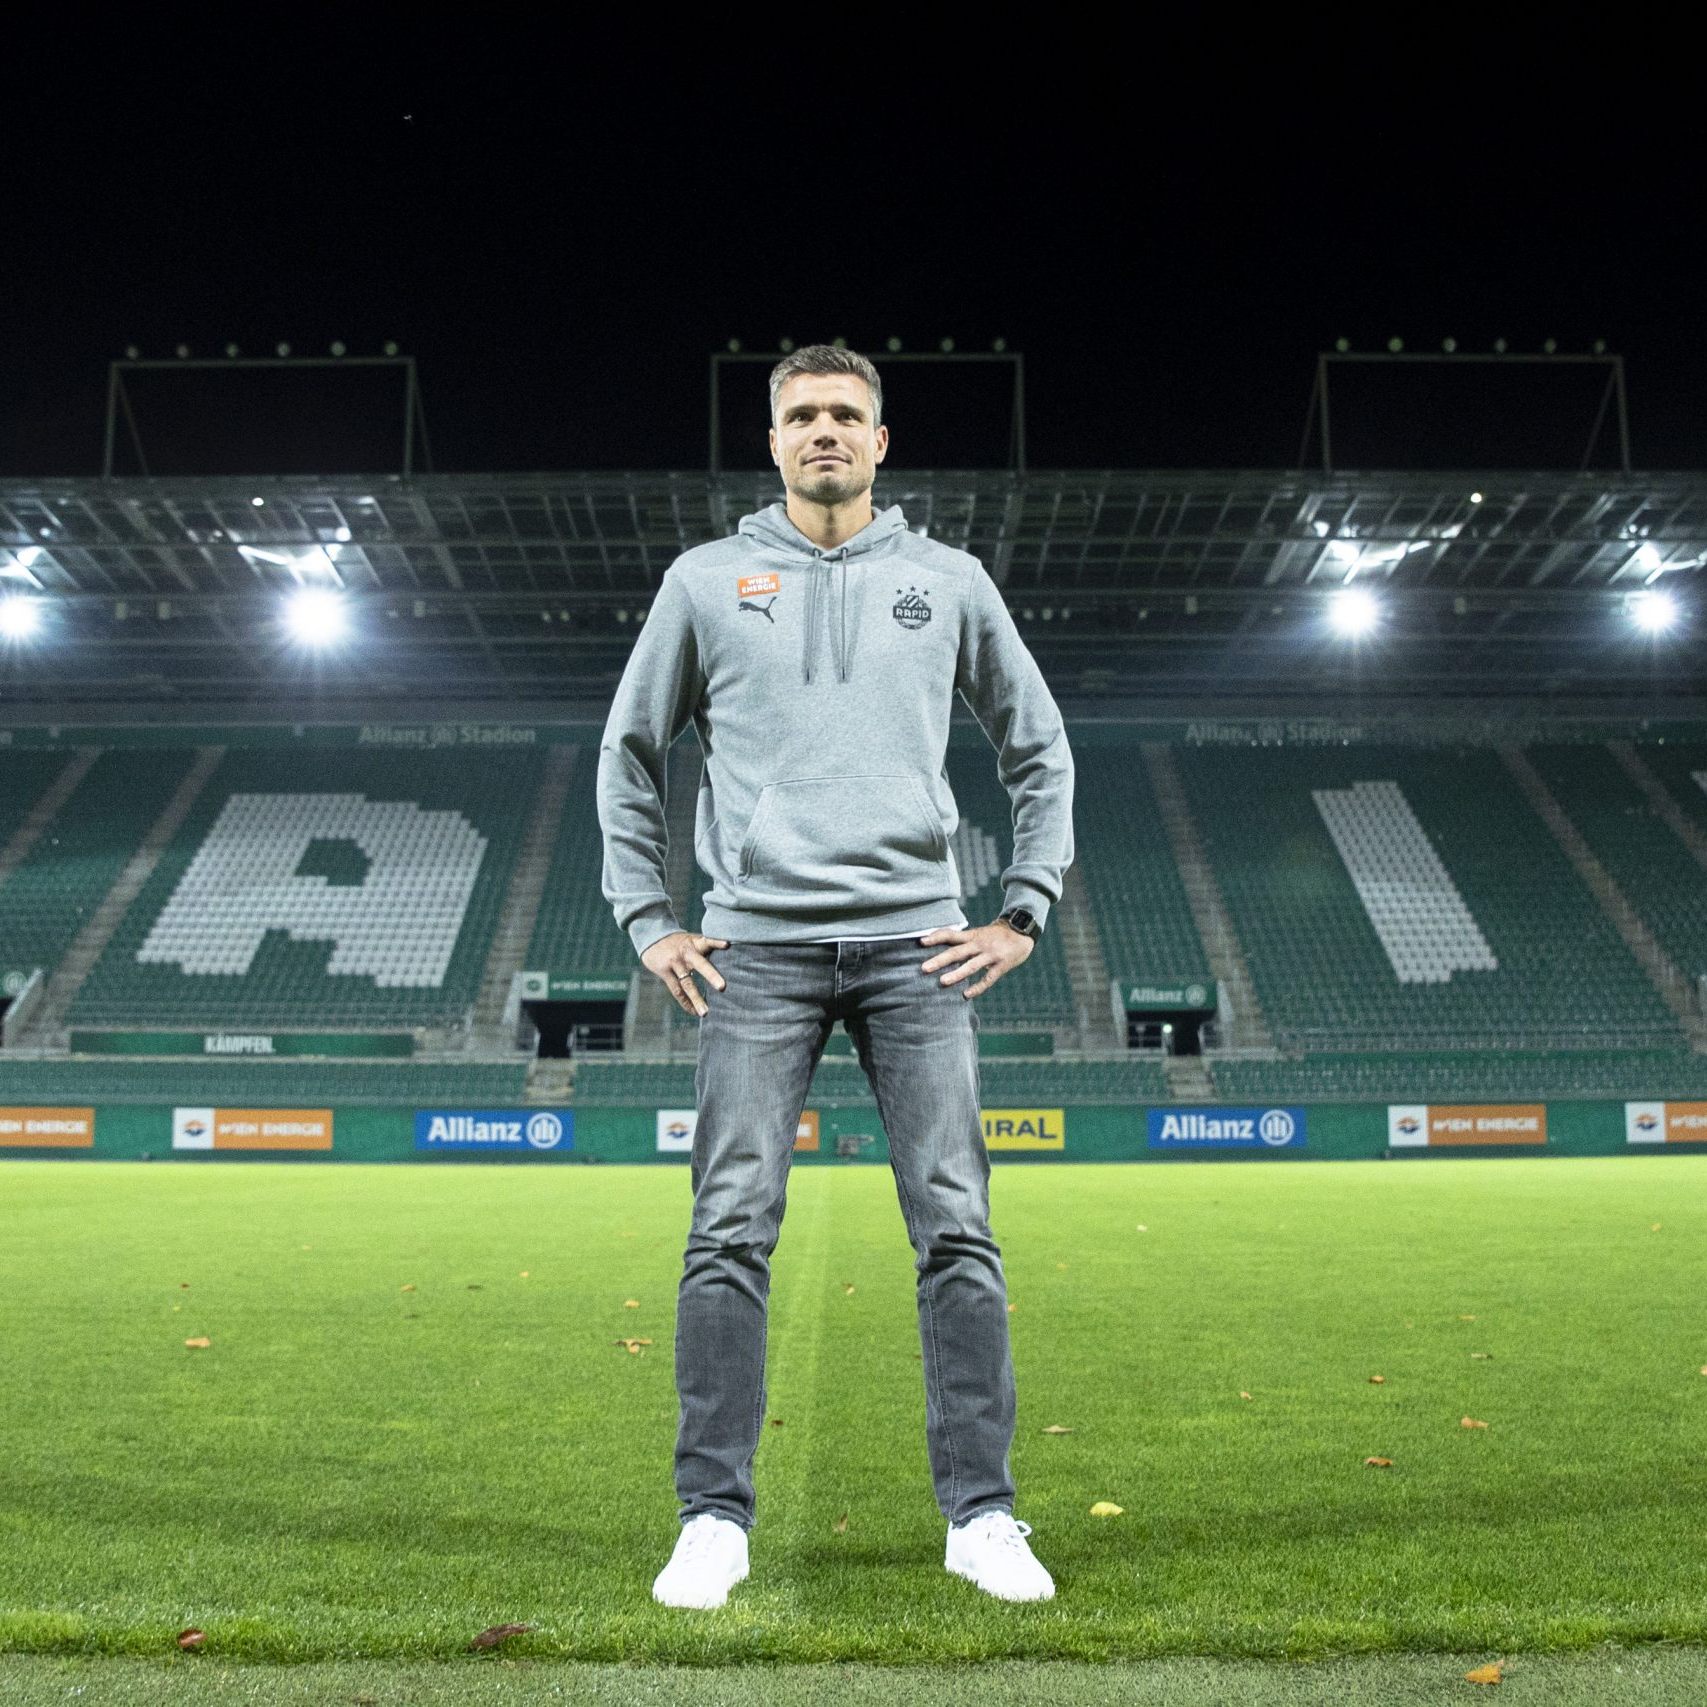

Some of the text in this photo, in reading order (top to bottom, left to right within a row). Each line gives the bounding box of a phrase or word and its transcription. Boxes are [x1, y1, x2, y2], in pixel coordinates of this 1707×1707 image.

[741, 582, 777, 593] ENERGIE
[895, 607, 930, 619] RAPID
[1129, 987, 1183, 1003] Allianz
[26, 1120, 87, 1133] ENERGIE
[262, 1123, 324, 1135] ENERGIE
[428, 1116, 522, 1142] Allianz
[985, 1117, 1057, 1139] IRAL
[1160, 1115, 1255, 1140] Allianz
[1476, 1117, 1539, 1130] ENERGIE
